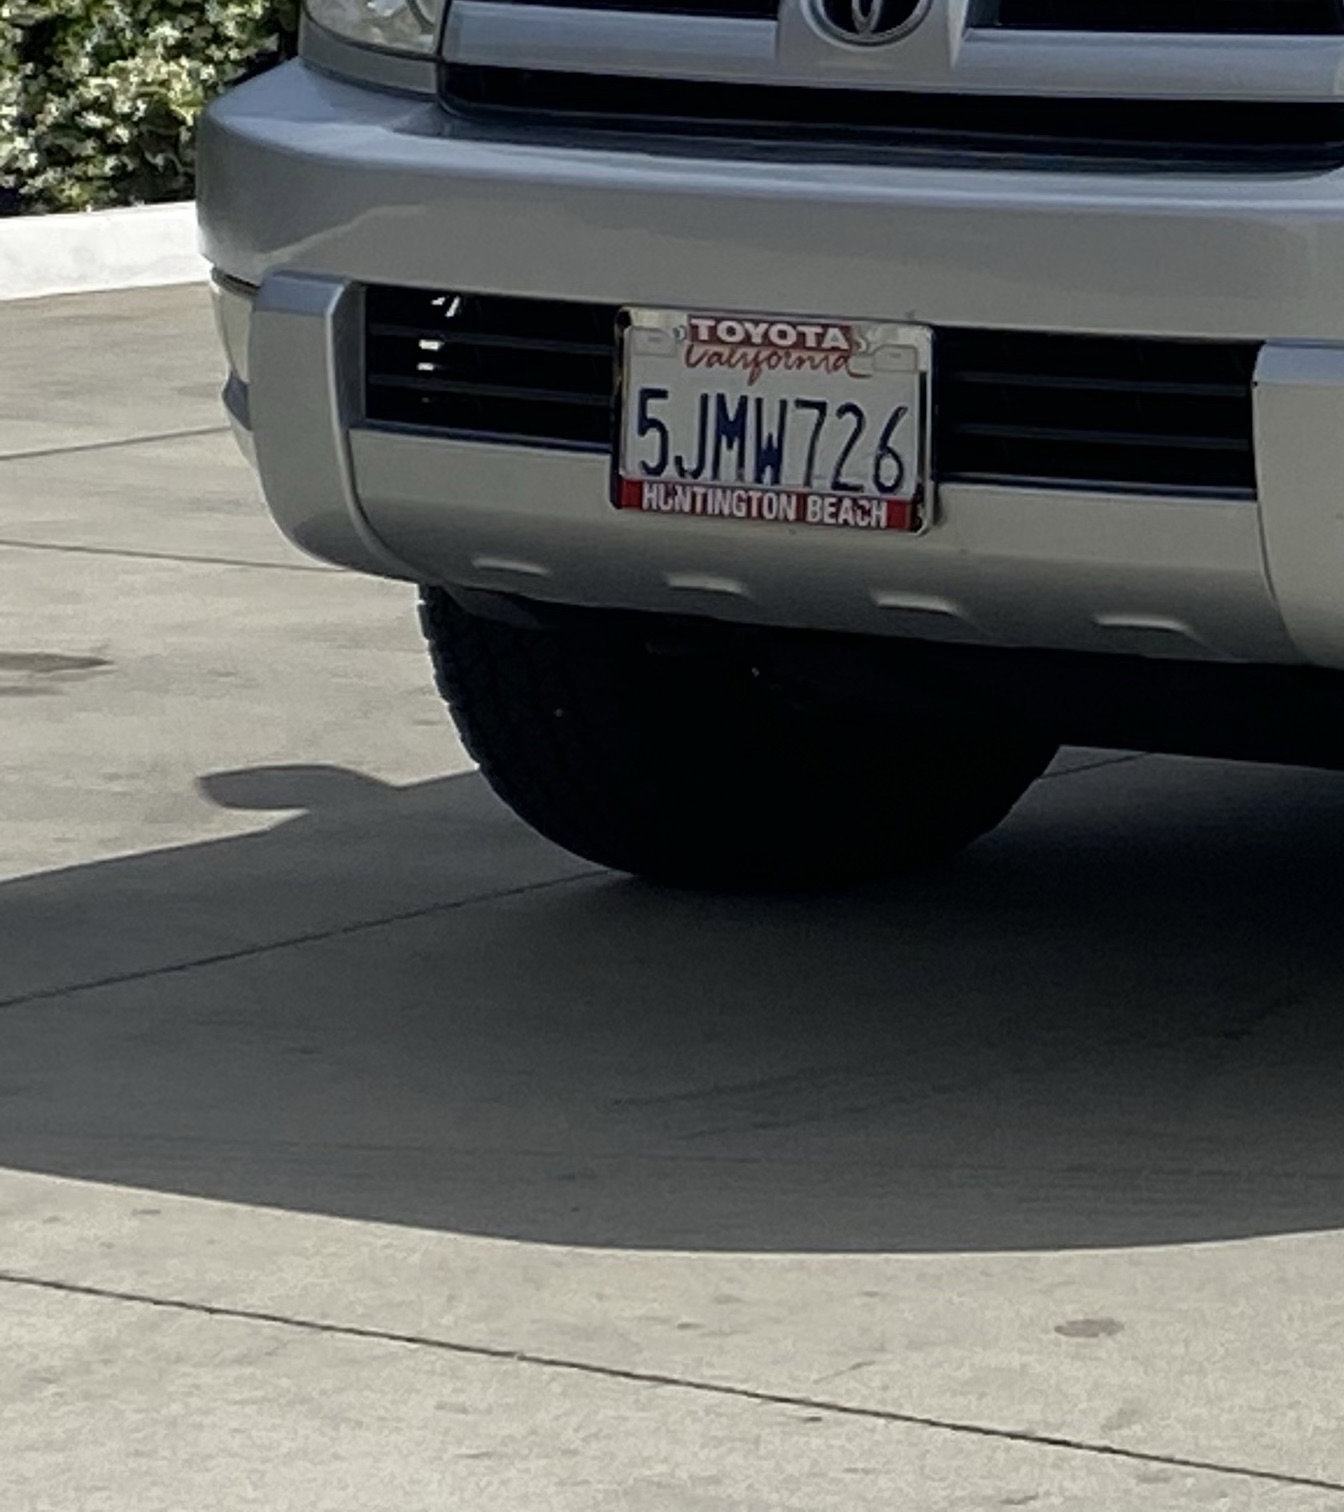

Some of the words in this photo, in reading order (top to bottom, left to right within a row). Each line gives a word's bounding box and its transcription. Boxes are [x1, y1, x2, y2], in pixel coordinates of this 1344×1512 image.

[690, 317, 850, 350] TOYOTA
[685, 343, 873, 387] California
[637, 387, 909, 494] 5JMW726
[641, 482, 798, 523] HUNTINGTON
[805, 499, 888, 529] BEACH
